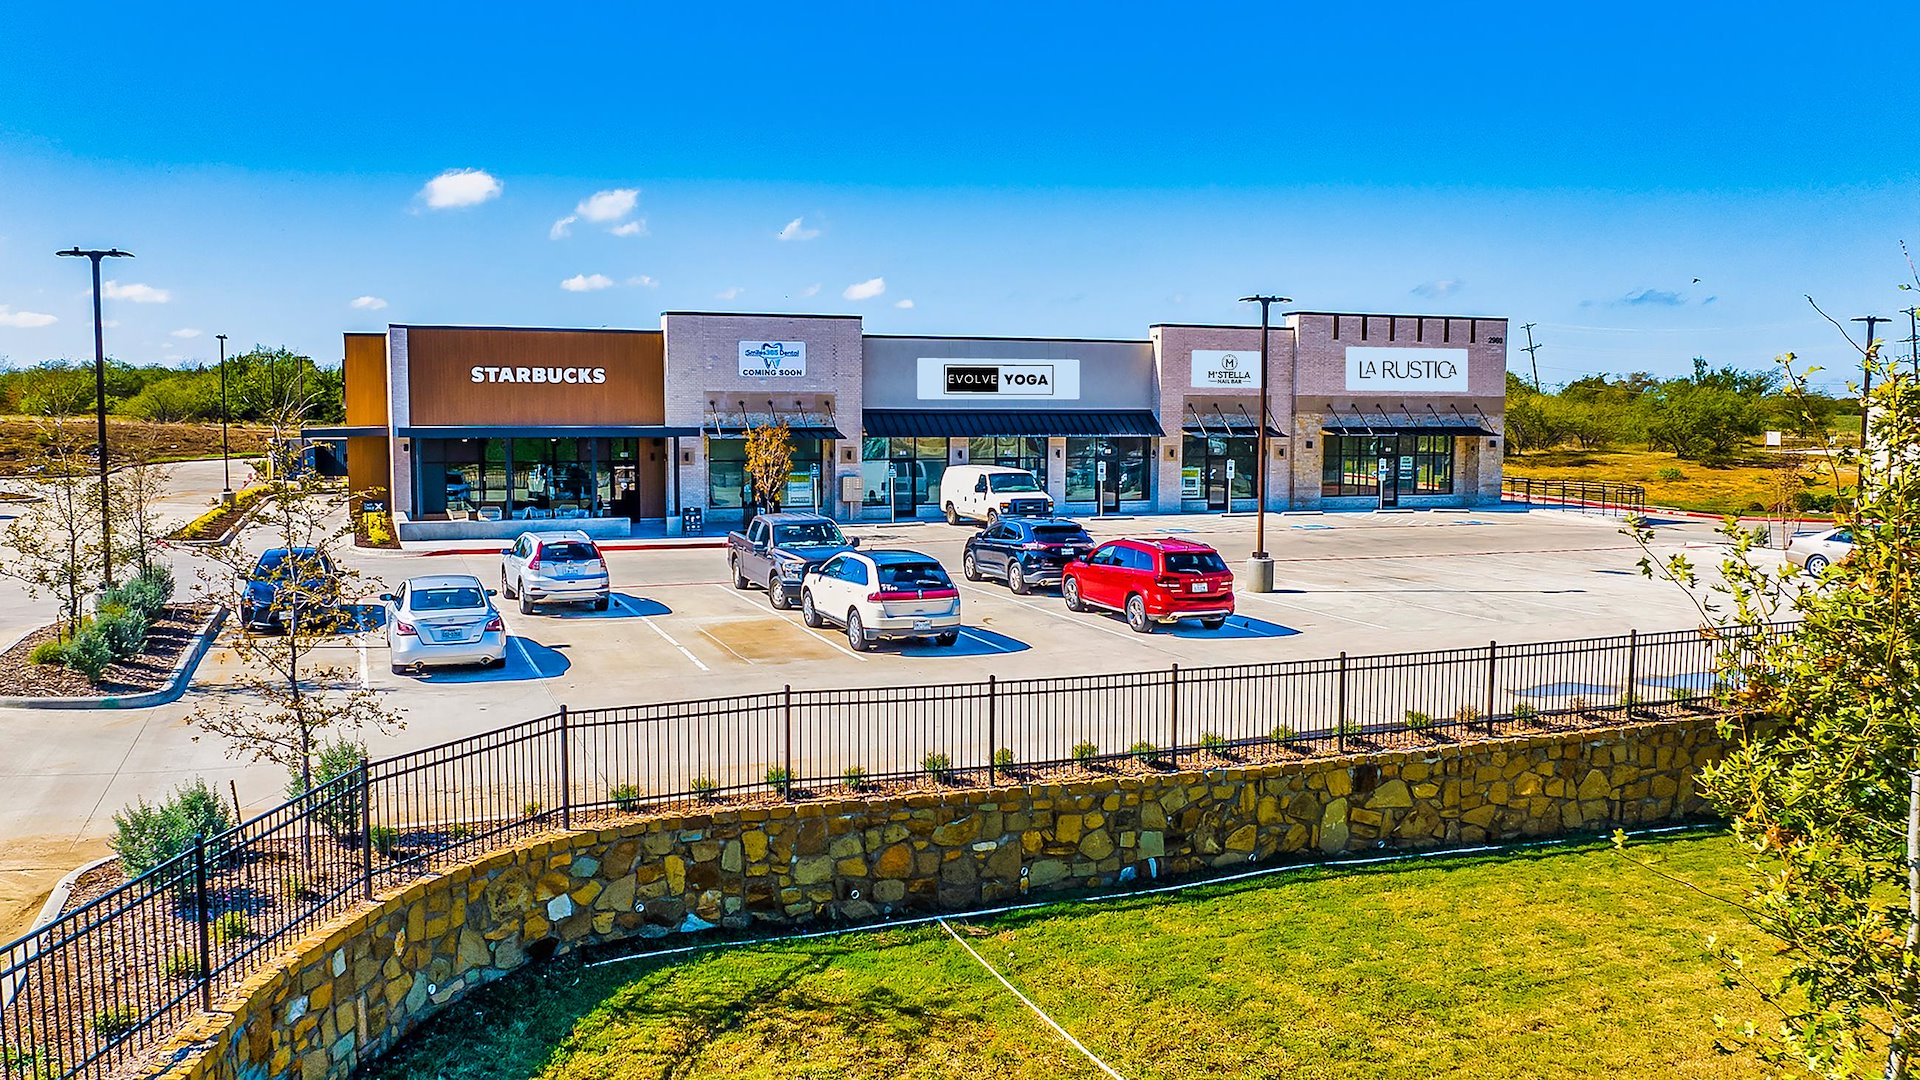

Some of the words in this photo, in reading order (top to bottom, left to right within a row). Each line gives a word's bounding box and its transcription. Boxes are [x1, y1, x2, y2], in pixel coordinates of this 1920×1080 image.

[779, 349, 800, 357] Dental
[1225, 358, 1234, 368] M
[471, 366, 606, 384] STARBUCKS
[1207, 371, 1252, 379] M'STELLA
[1359, 360, 1377, 379] LA
[1382, 360, 1458, 379] RUSTICA
[947, 374, 998, 385] EVOLVE
[1003, 374, 1049, 386] YOGA
